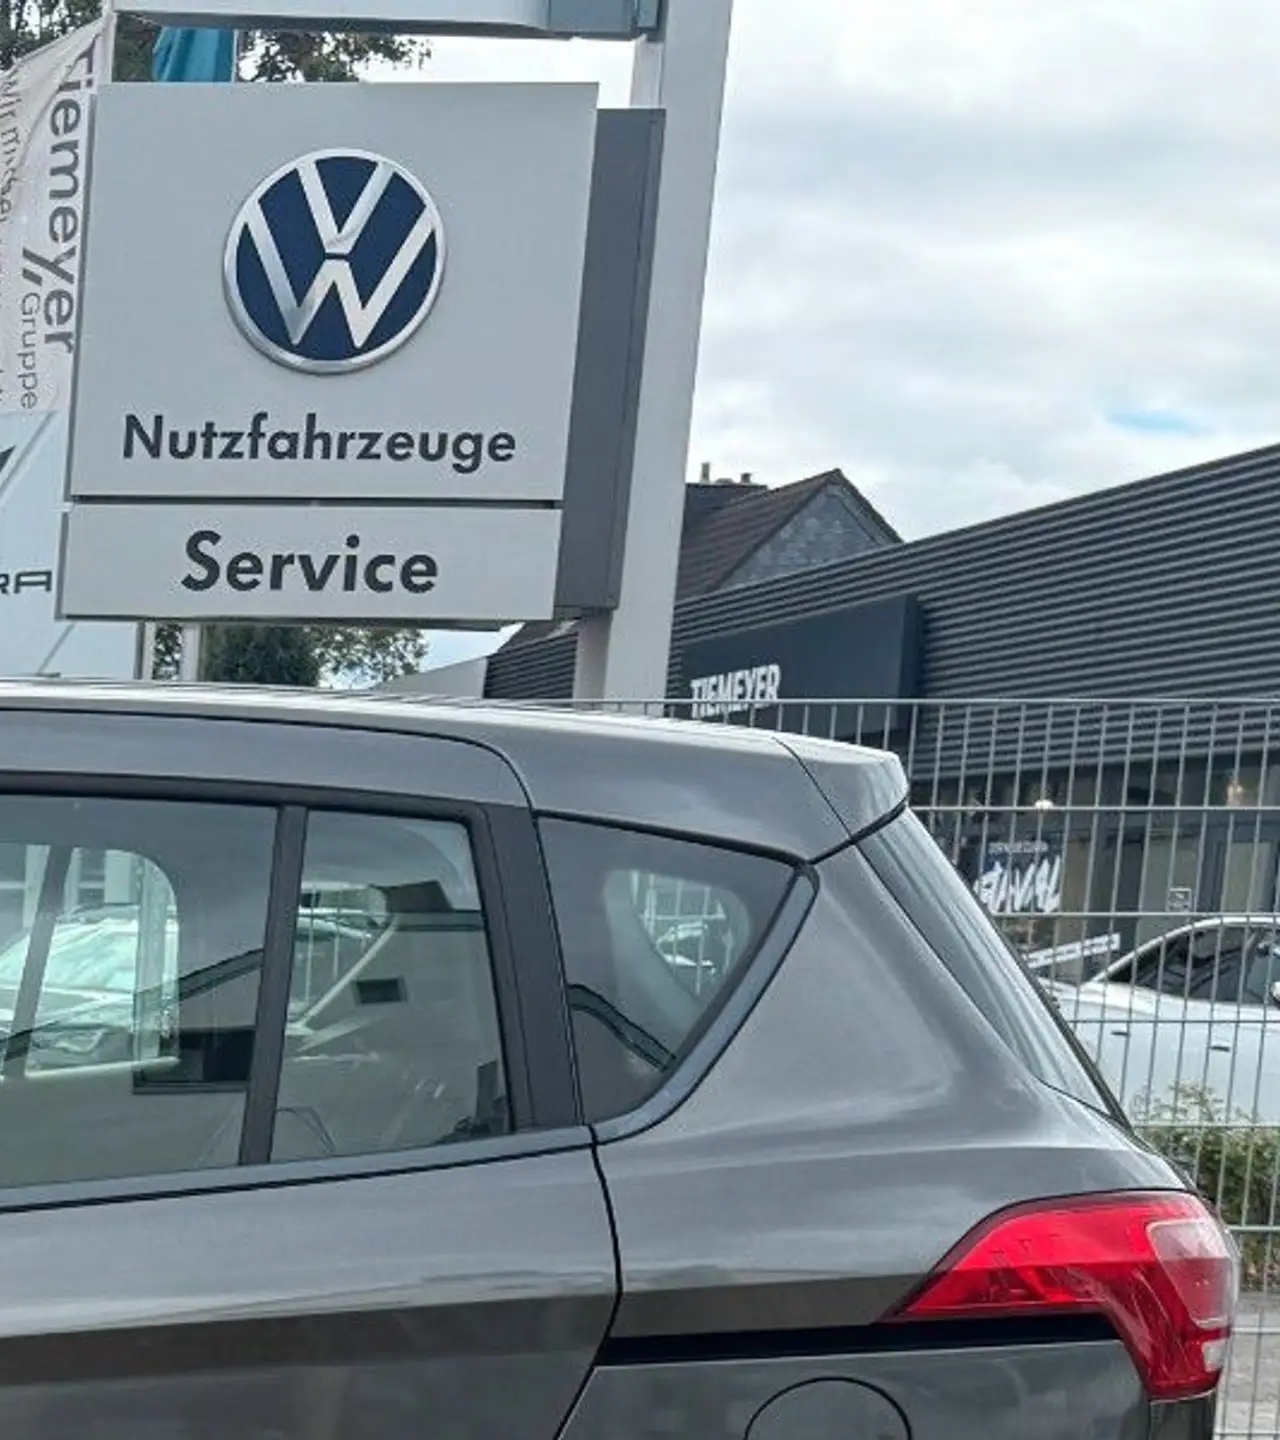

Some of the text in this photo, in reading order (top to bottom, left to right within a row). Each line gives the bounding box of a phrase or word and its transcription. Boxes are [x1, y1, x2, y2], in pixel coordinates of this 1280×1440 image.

[16, 292, 42, 410] Gruppe
[123, 412, 516, 474] Nutzfahrzeuge
[181, 529, 438, 593] Service
[690, 664, 781, 719] TIEMEYER
